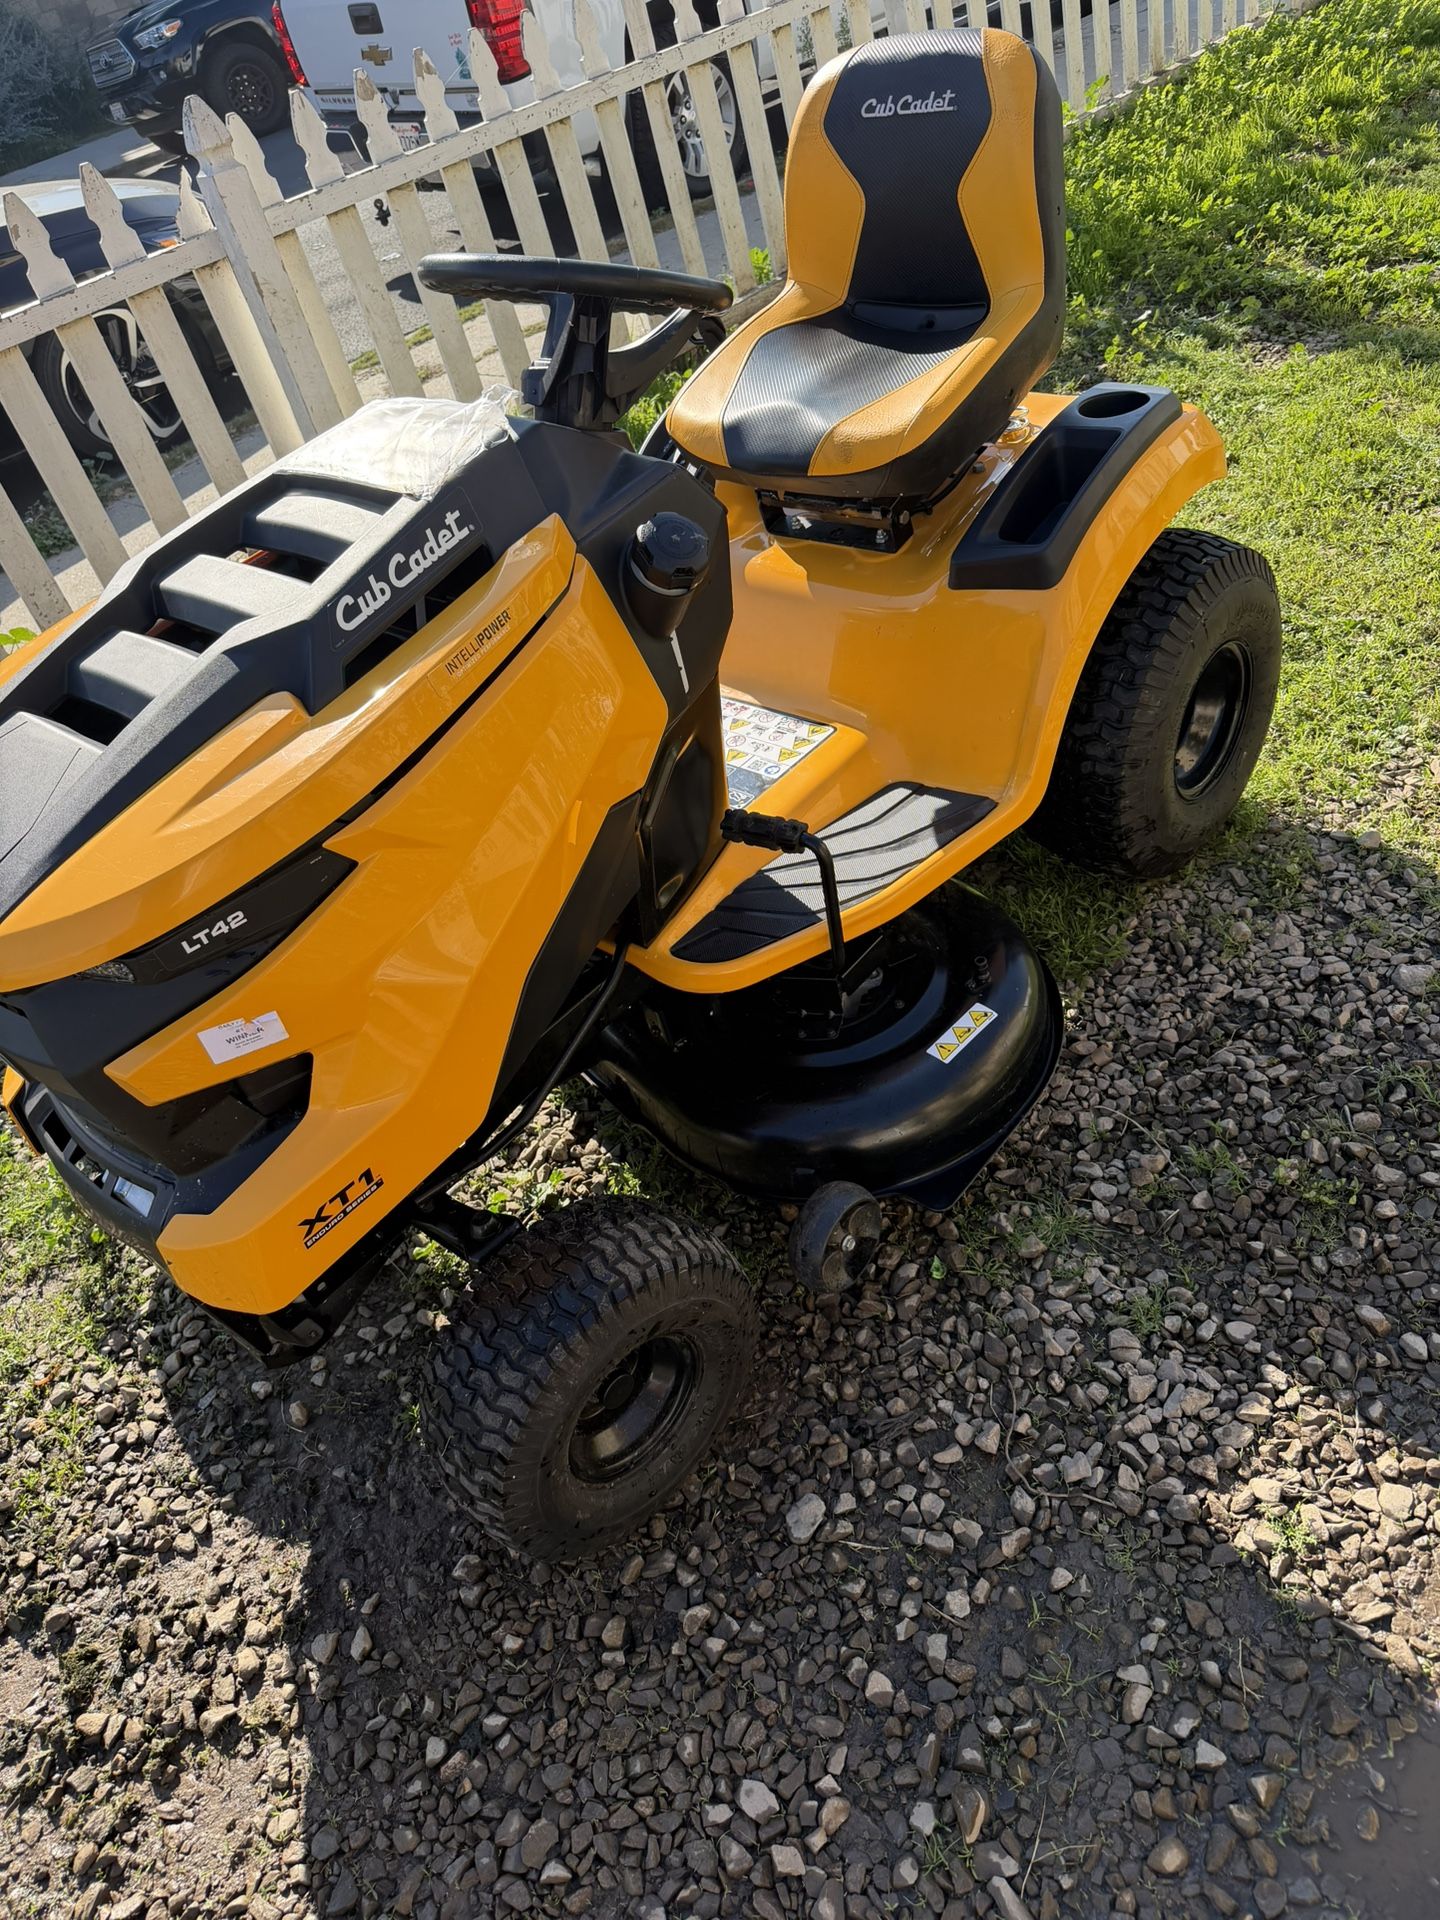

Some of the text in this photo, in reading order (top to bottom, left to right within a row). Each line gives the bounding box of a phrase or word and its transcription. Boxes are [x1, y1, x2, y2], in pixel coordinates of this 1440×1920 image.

[861, 89, 956, 118] Cub Cadet
[335, 509, 470, 632] Cub Cadet
[444, 609, 512, 676] INTELLIPOWER
[180, 910, 249, 954] LT42
[297, 1167, 375, 1241] XT1
[306, 1184, 378, 1248] ENDURO SERIES
